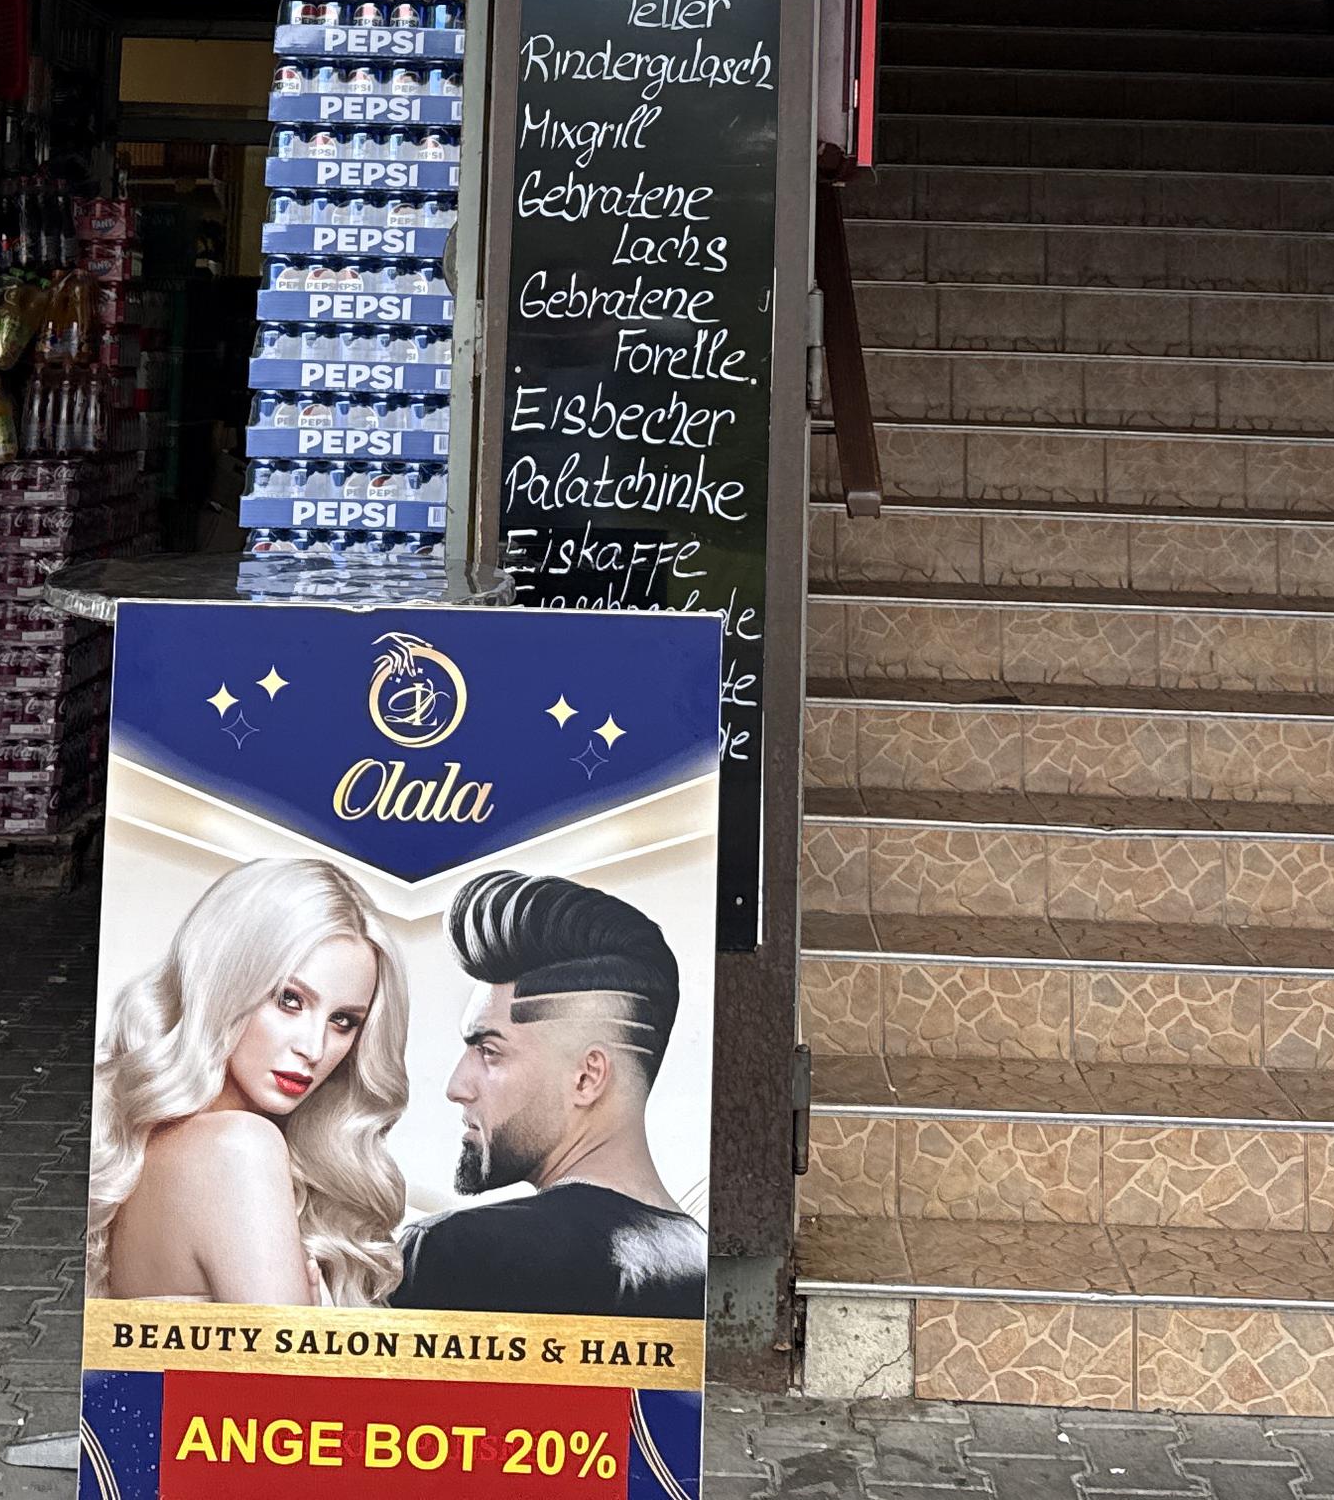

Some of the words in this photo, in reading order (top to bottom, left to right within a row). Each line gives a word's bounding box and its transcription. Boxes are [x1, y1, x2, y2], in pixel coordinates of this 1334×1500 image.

[324, 29, 424, 54] PEPSI
[521, 35, 774, 101] Rindergulasch
[320, 97, 421, 121] PEPSI
[520, 104, 662, 168] Mixgrill
[317, 162, 418, 187] PEPSI
[518, 171, 713, 222] Gebratene
[313, 228, 415, 252] PEPSI
[612, 224, 727, 271] Lachs
[309, 295, 411, 319] PEPSI
[519, 270, 720, 322] Gebratene
[301, 363, 404, 388] PEPSI
[511, 383, 735, 448] Eisbecher
[299, 430, 402, 455] PEPSI
[292, 502, 396, 526] PEPSI
[331, 757, 494, 824] Olala
[113, 1323, 262, 1353] BEAUTY
[275, 1328, 400, 1357] SALON
[414, 1333, 527, 1362] NAILS
[541, 1338, 564, 1364] &
[580, 1339, 676, 1368] HAIR
[177, 1416, 346, 1466] ANGE
[365, 1423, 486, 1472] BOT
[502, 1429, 617, 1479] 20%
